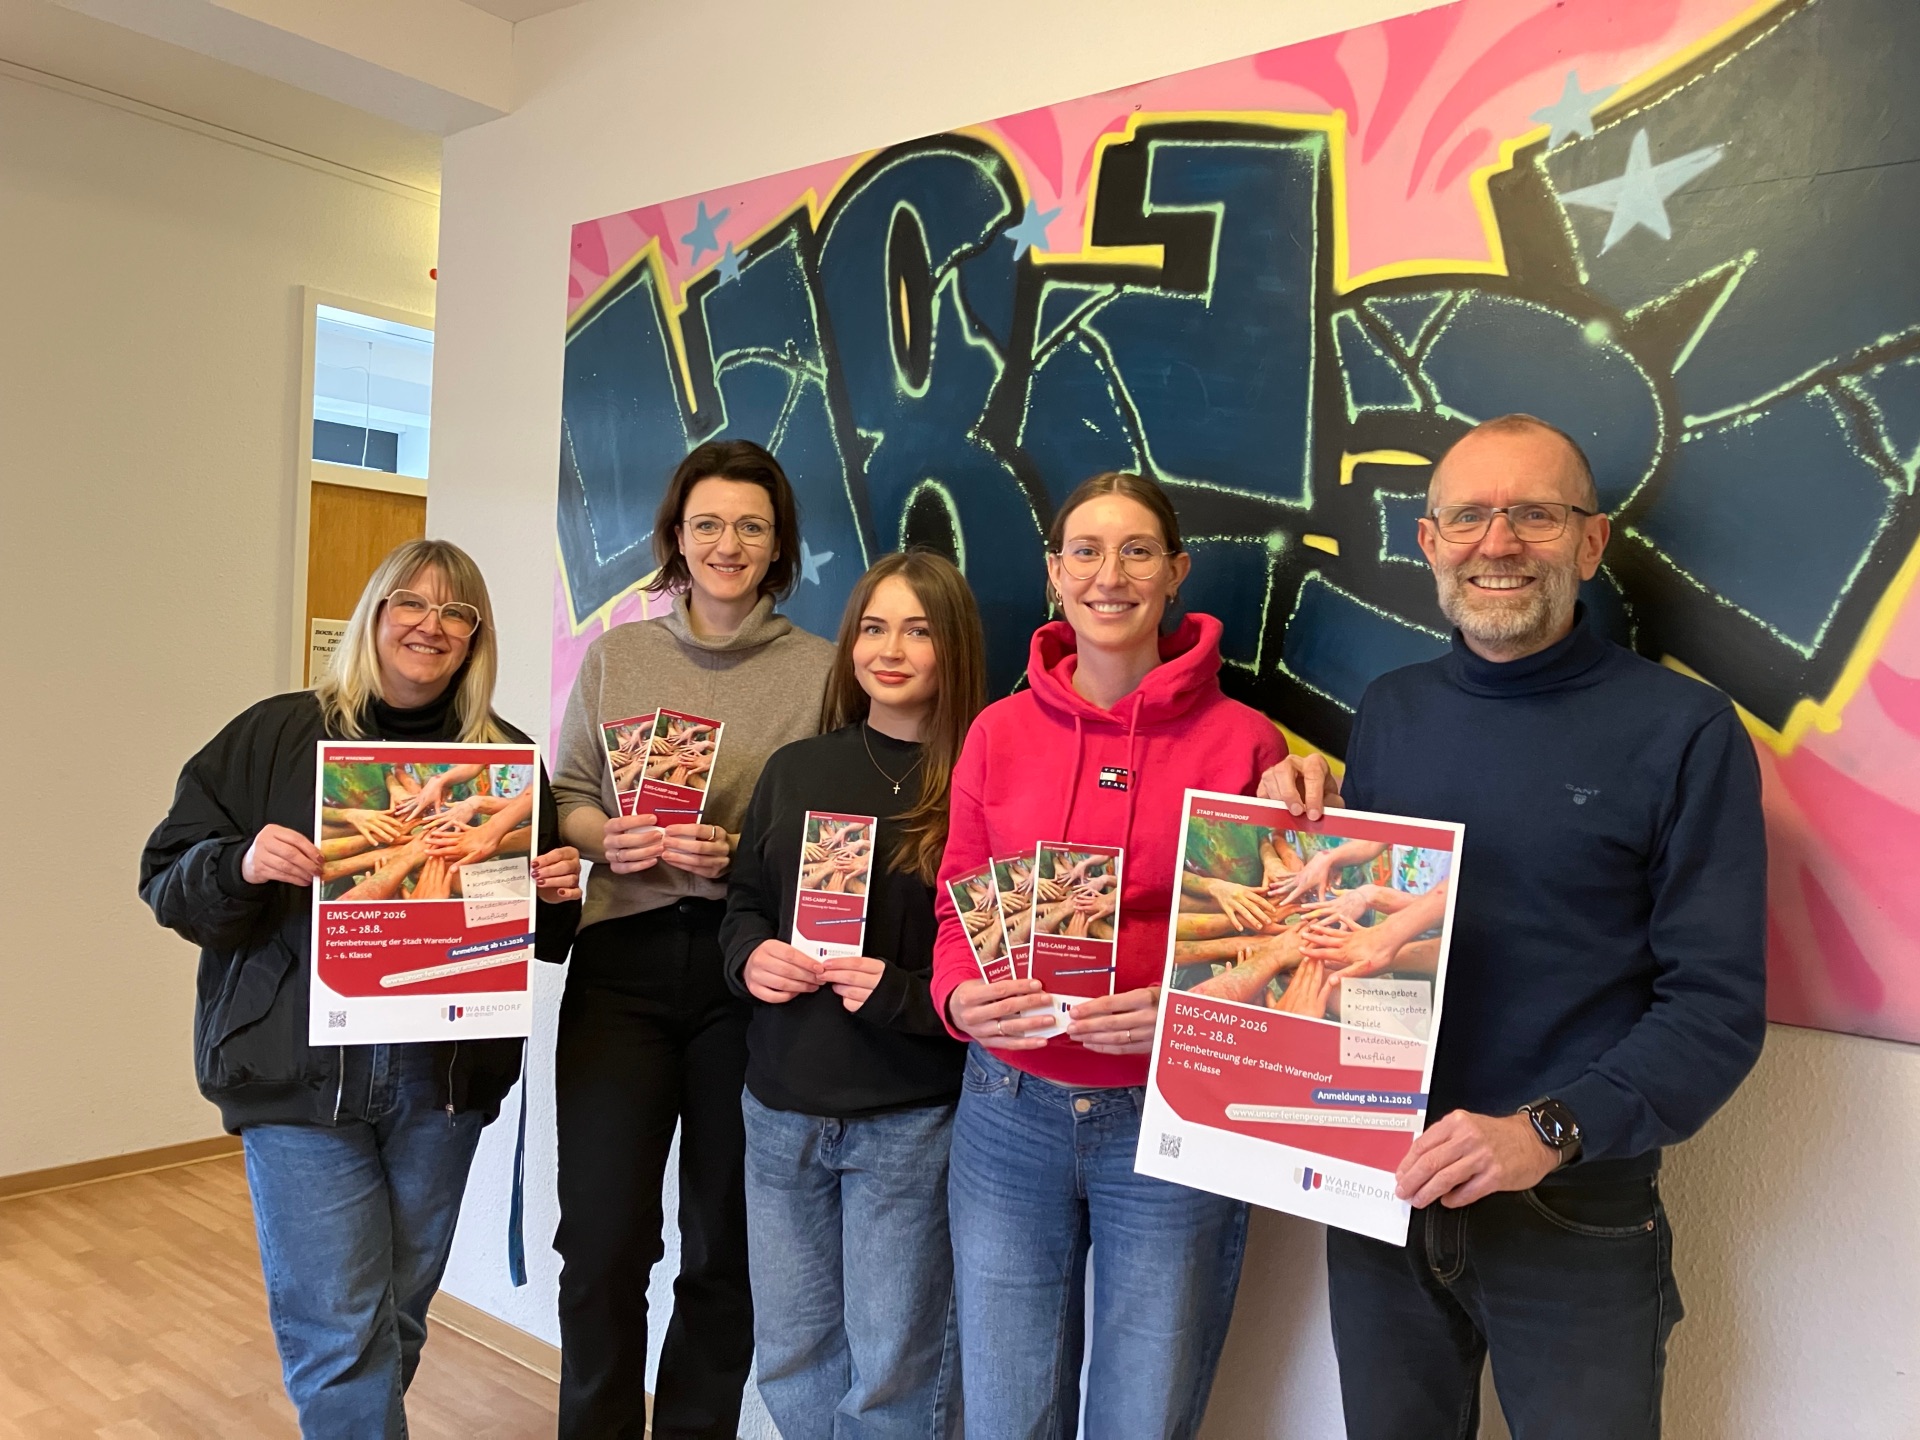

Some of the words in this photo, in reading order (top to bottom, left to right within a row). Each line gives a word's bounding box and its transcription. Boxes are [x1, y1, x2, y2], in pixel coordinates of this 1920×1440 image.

[1102, 780, 1128, 789] JEAN
[1565, 784, 1600, 796] GANT
[1214, 811, 1250, 820] WARENDORF
[326, 911, 381, 920] EMS-CAMP
[383, 910, 407, 919] 2026
[326, 925, 348, 935] 17.8.
[358, 925, 383, 934] 28.8.
[326, 939, 387, 947] Ferienbetreuung
[423, 936, 462, 944] Warendorf
[452, 943, 489, 955] Anmeldung
[500, 939, 524, 947] 1.2.2026
[1037, 942, 1066, 950] EMS-CAMP
[1016, 952, 1028, 960] EMS
[1355, 988, 1418, 998] Sportangebote
[466, 1004, 522, 1012] WARENDORF
[1355, 1004, 1427, 1015] Kreativangebote
[1174, 1004, 1238, 1026] EMS-CAMP
[1240, 1018, 1268, 1032] 2026
[1354, 1020, 1381, 1028] Spiele
[1172, 1024, 1196, 1036] 17.8.
[1209, 1031, 1237, 1045] 28.8.
[1354, 1036, 1422, 1048] Entdeckungen
[1170, 1040, 1240, 1064] Ferienbetreuung
[1242, 1056, 1258, 1066] der
[1260, 1059, 1282, 1072] Stadt
[1284, 1065, 1332, 1083] Warendorf
[1354, 1052, 1396, 1064] Ausflüge
[1168, 1056, 1174, 1064] 2.
[1184, 1060, 1192, 1069] 6.
[1194, 1062, 1221, 1076] Klasse
[1318, 1091, 1366, 1104] Anmeldung
[1367, 1092, 1378, 1102] ab
[1379, 1095, 1412, 1104] 1.2.2026
[1232, 1108, 1409, 1128] www.unser-ferienprogramm.de/warendorf
[1324, 1184, 1334, 1192] DIE
